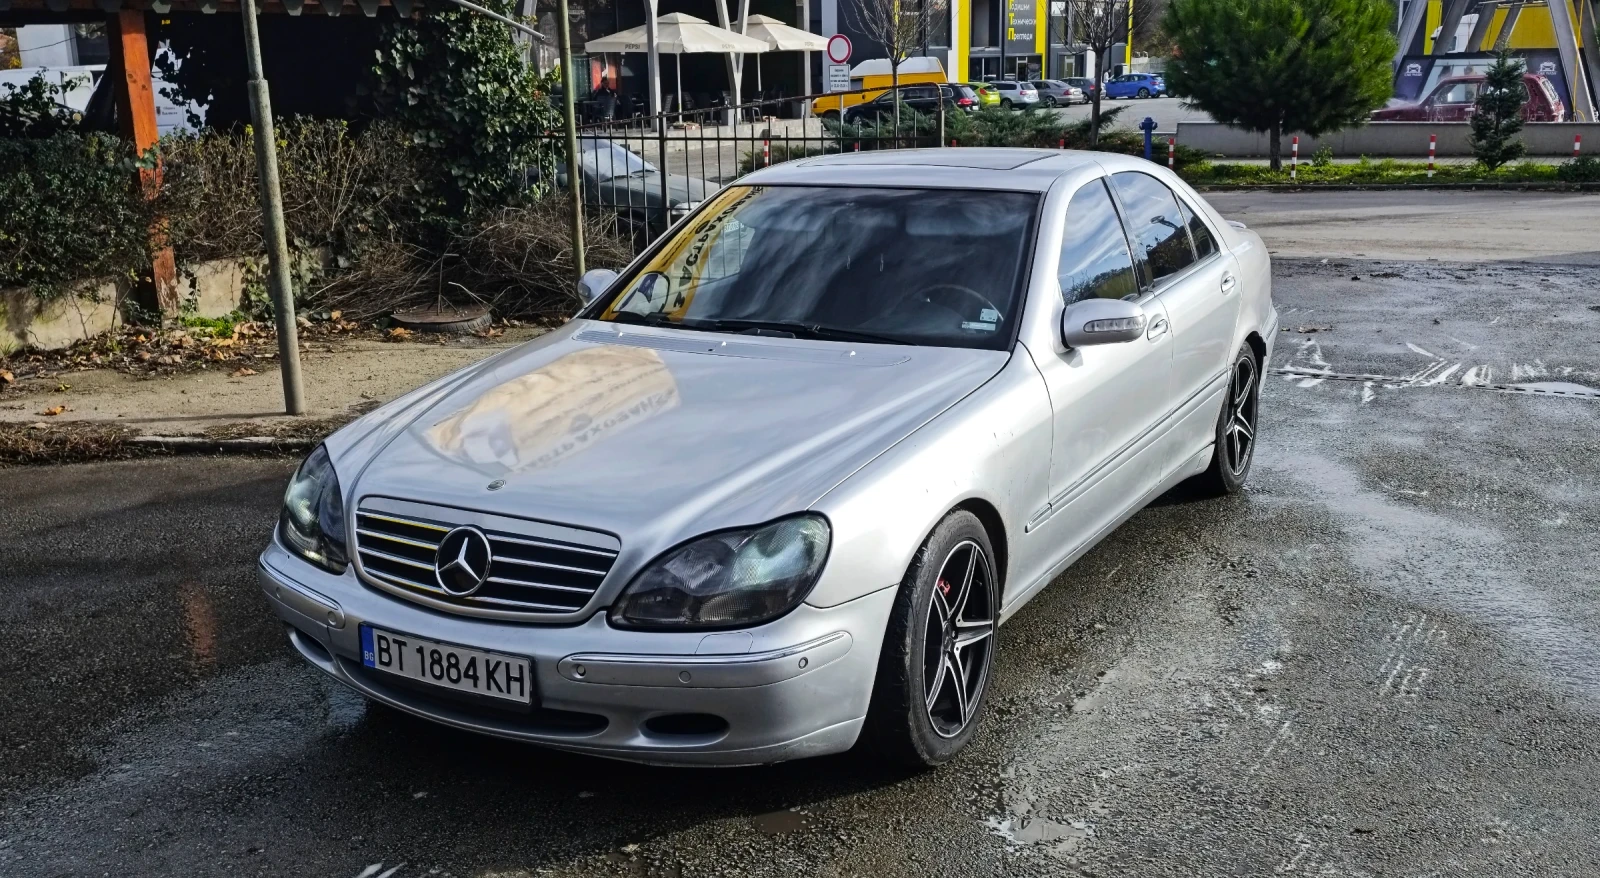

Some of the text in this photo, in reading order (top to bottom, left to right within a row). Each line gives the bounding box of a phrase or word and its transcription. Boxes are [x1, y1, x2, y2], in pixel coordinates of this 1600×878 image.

[1008, 28, 1033, 41] Прегледи
[364, 651, 374, 662] BG
[377, 634, 407, 671] BT
